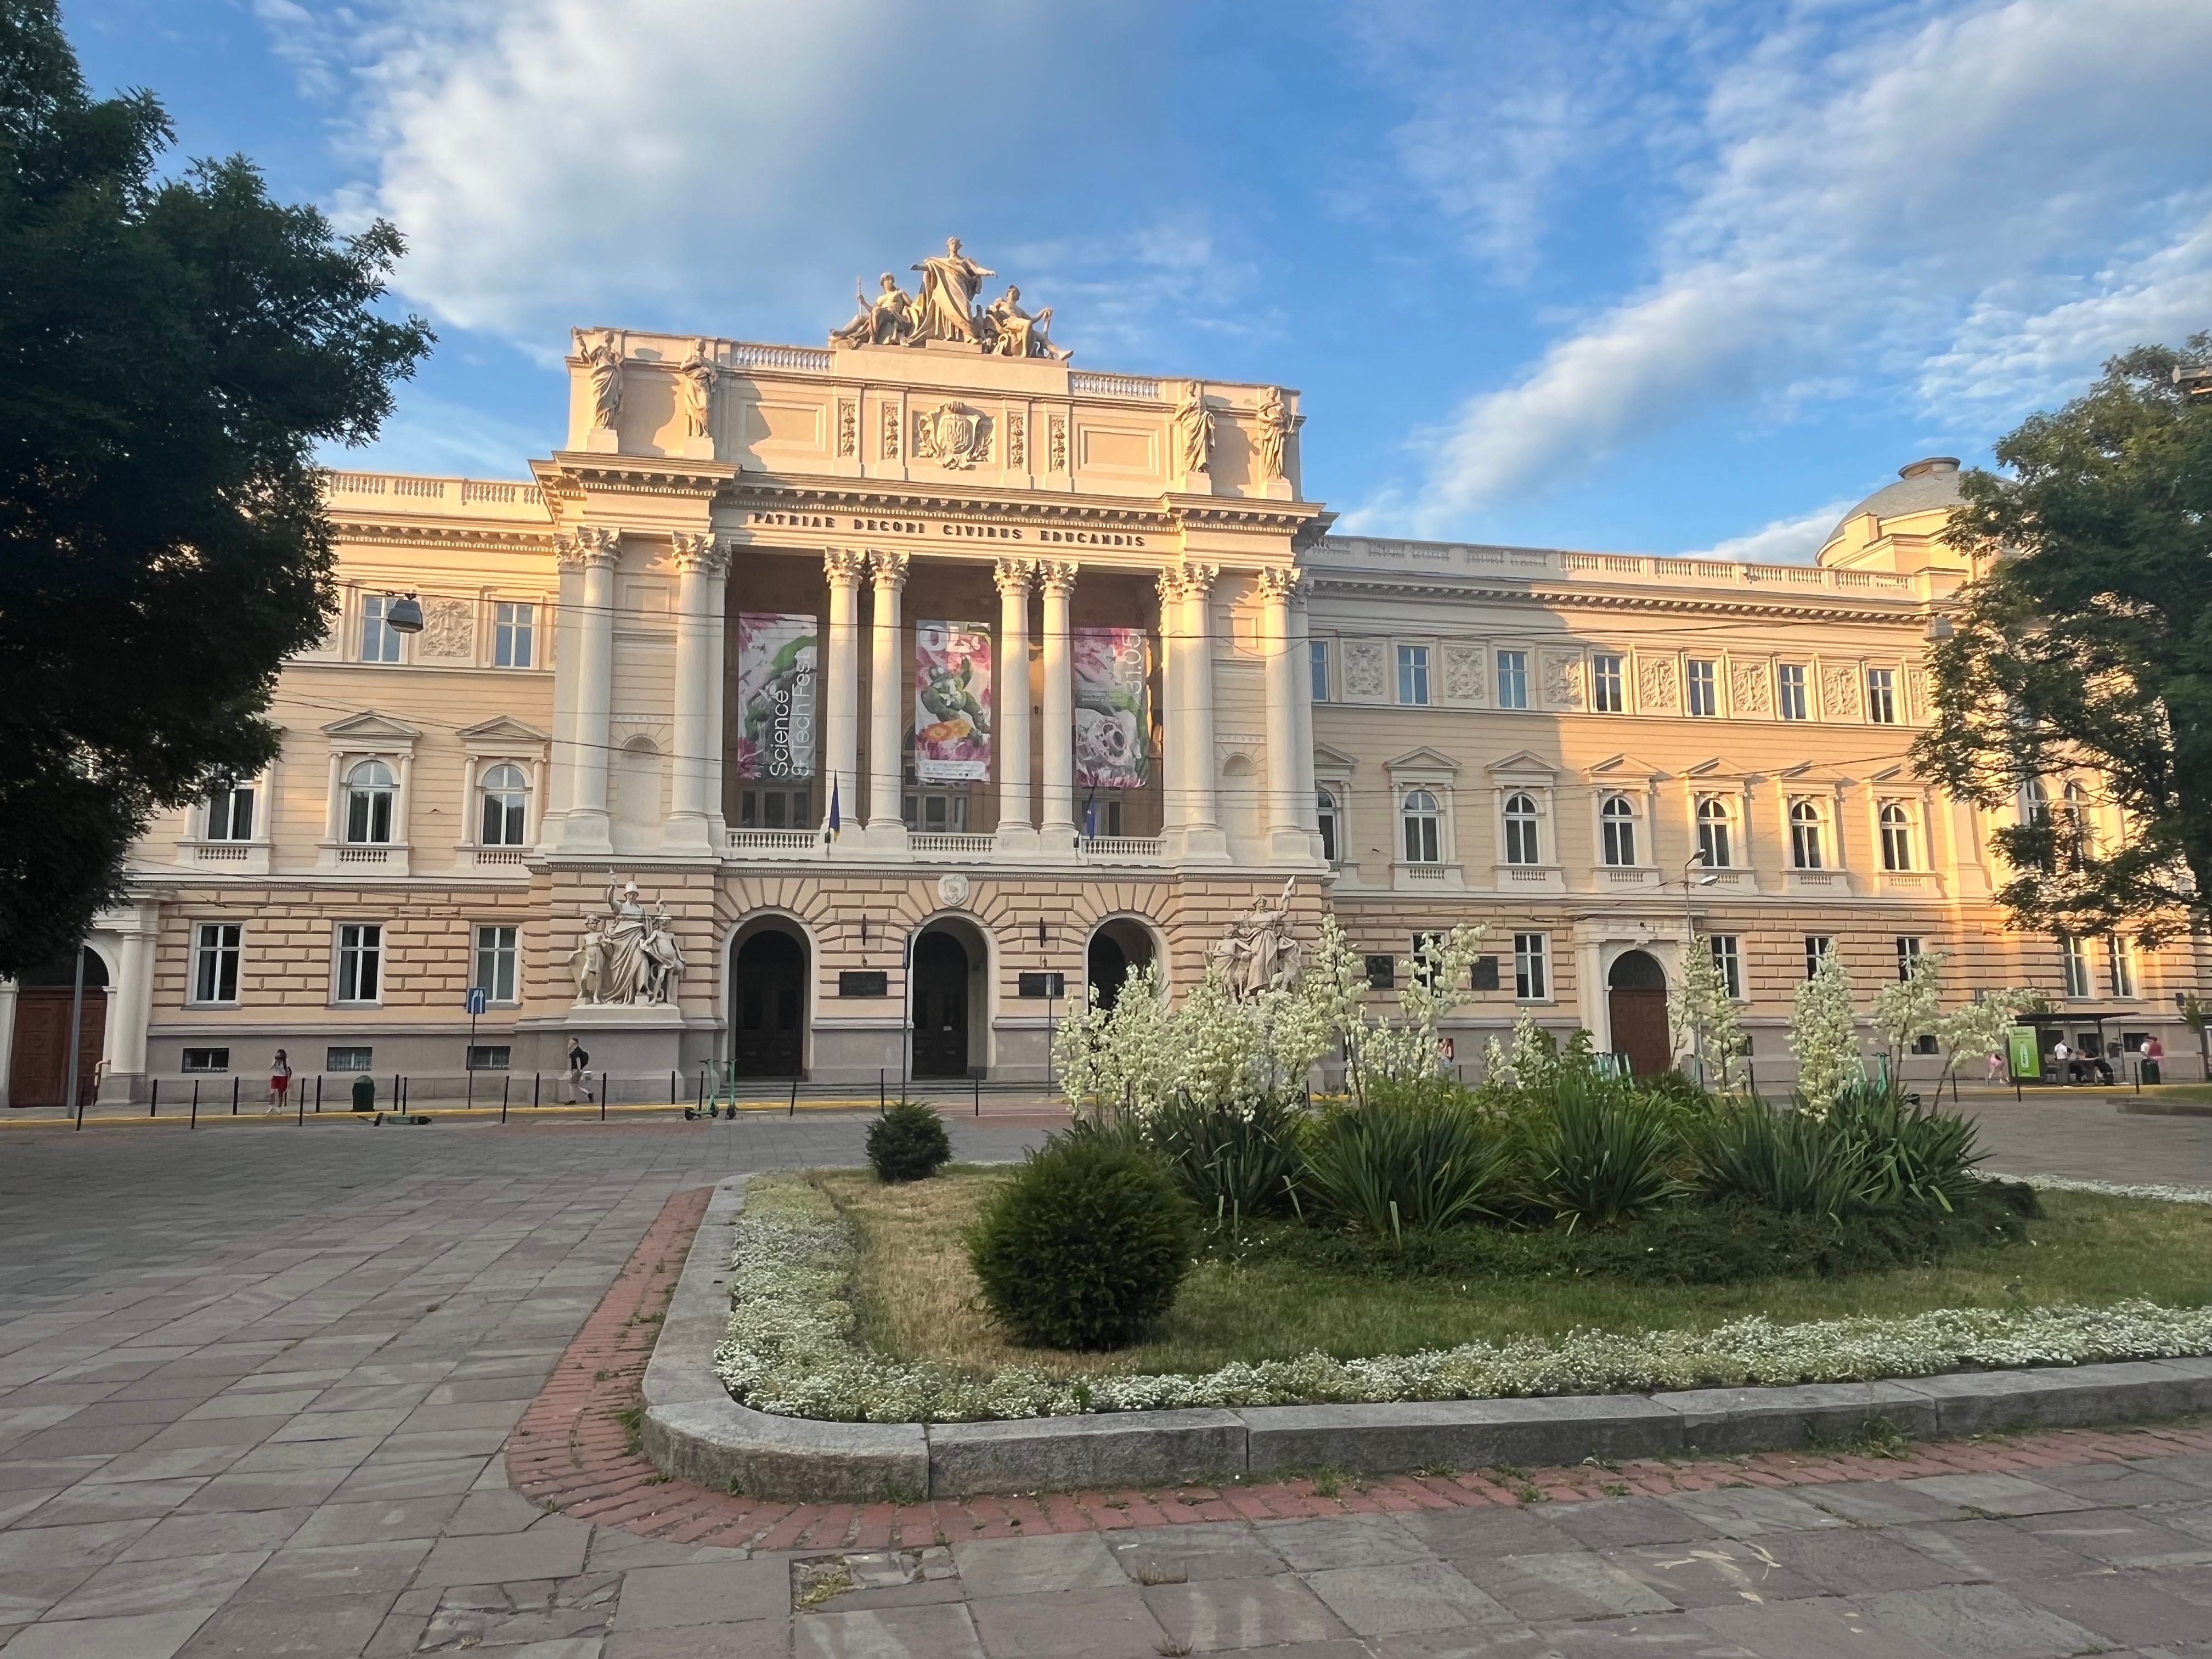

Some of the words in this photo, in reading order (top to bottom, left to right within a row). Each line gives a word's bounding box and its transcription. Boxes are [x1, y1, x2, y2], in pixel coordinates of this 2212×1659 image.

[754, 512, 836, 528] PATRIAE
[854, 518, 925, 533] DECORI
[943, 524, 1023, 539] CIVIBUS
[1040, 530, 1146, 547] EDUCANDIS
[791, 650, 810, 697] Fest
[1122, 633, 1142, 695] 31.05
[769, 690, 788, 776] Science
[791, 704, 810, 755] Tech
[791, 759, 810, 776] &
